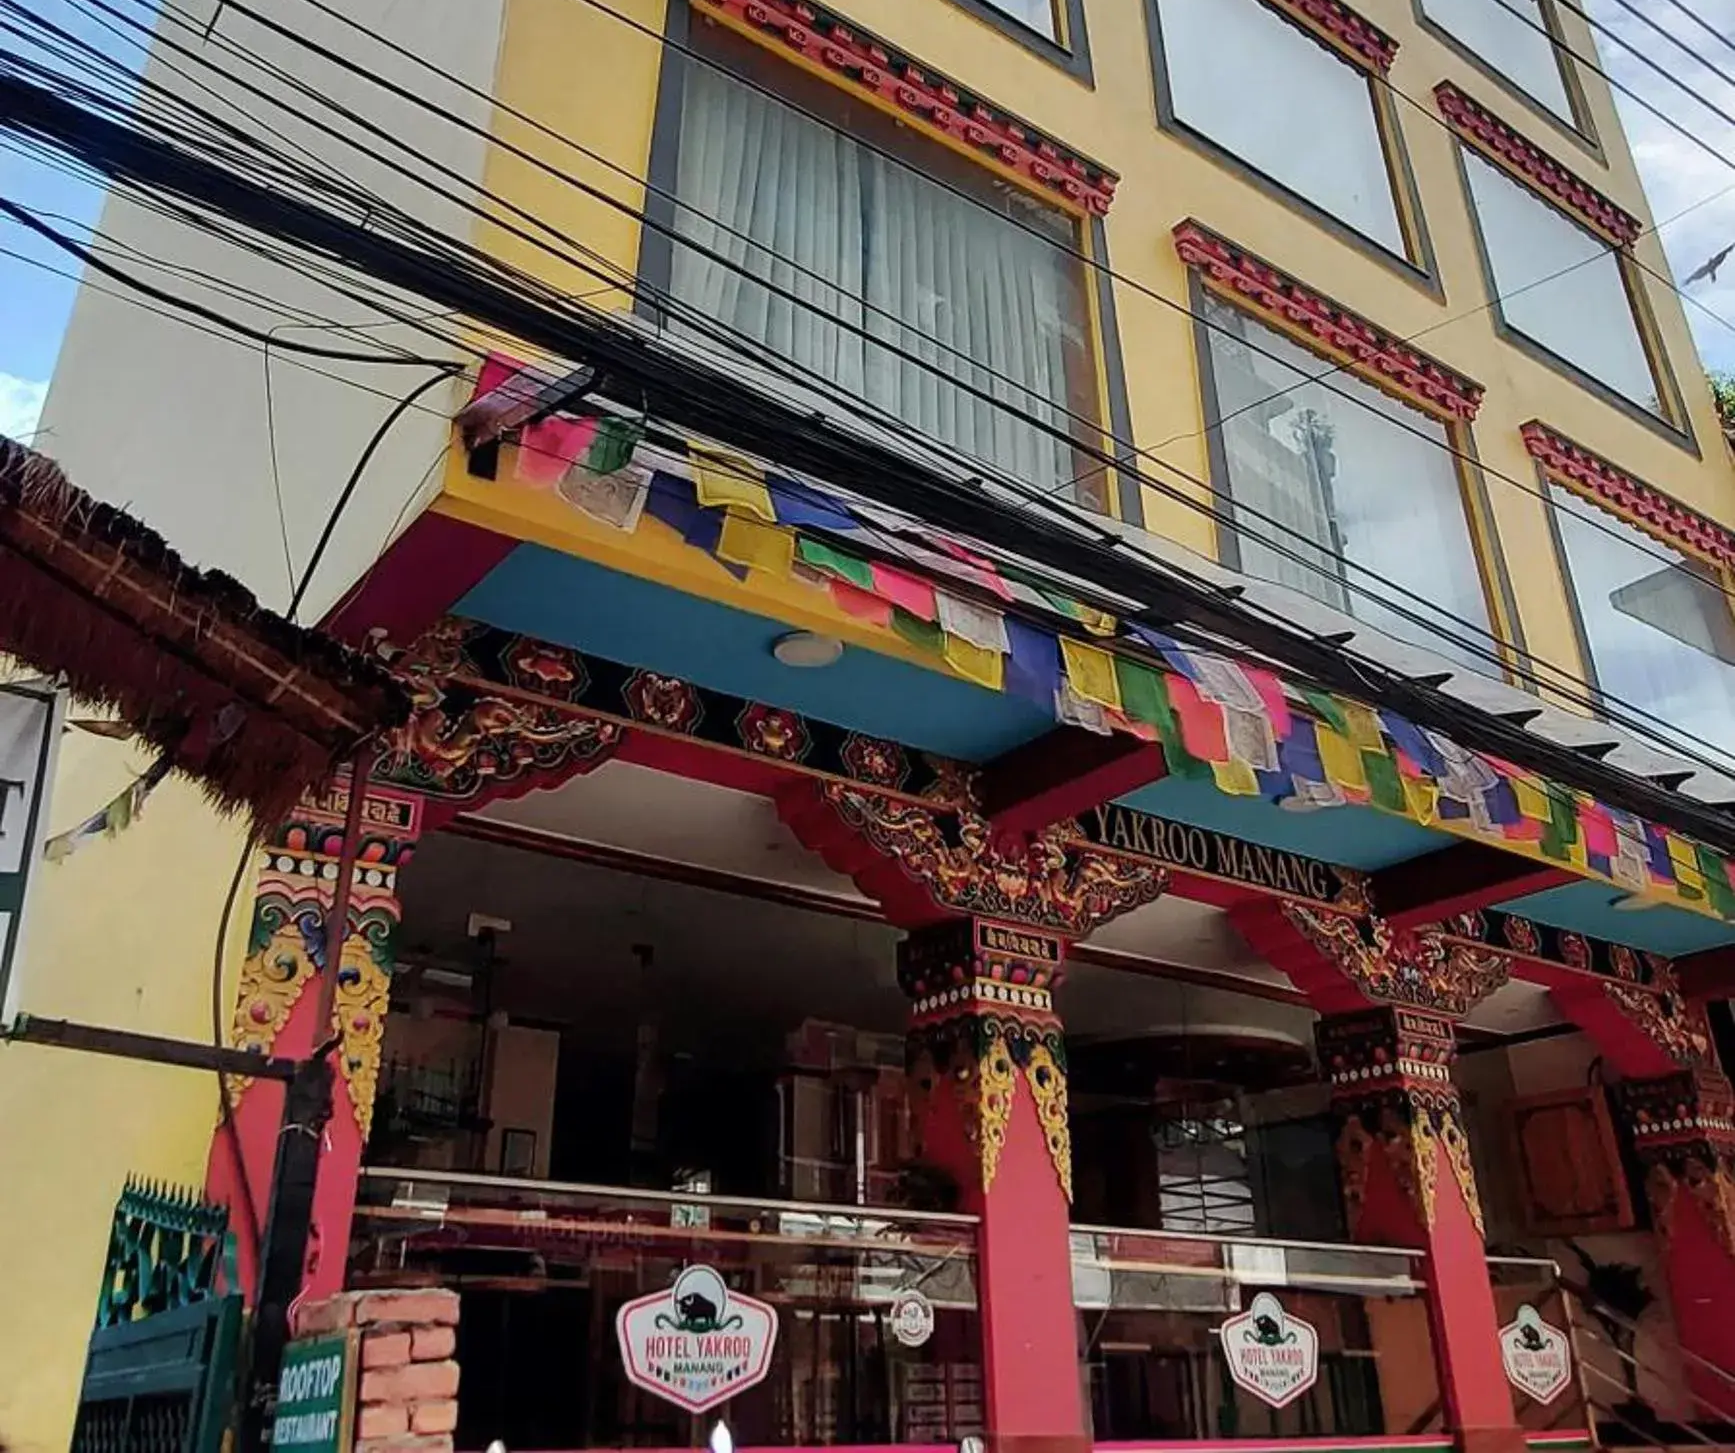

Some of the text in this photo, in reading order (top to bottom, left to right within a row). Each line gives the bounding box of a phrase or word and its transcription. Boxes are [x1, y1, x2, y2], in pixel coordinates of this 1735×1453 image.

[1095, 804, 1328, 899] YAKROO MANANG
[645, 1336, 752, 1359] HOTEL YAKROO
[279, 1354, 342, 1402] ROOFTOP
[673, 1361, 723, 1374] MANANG
[273, 1409, 339, 1445] RESTAURANT
